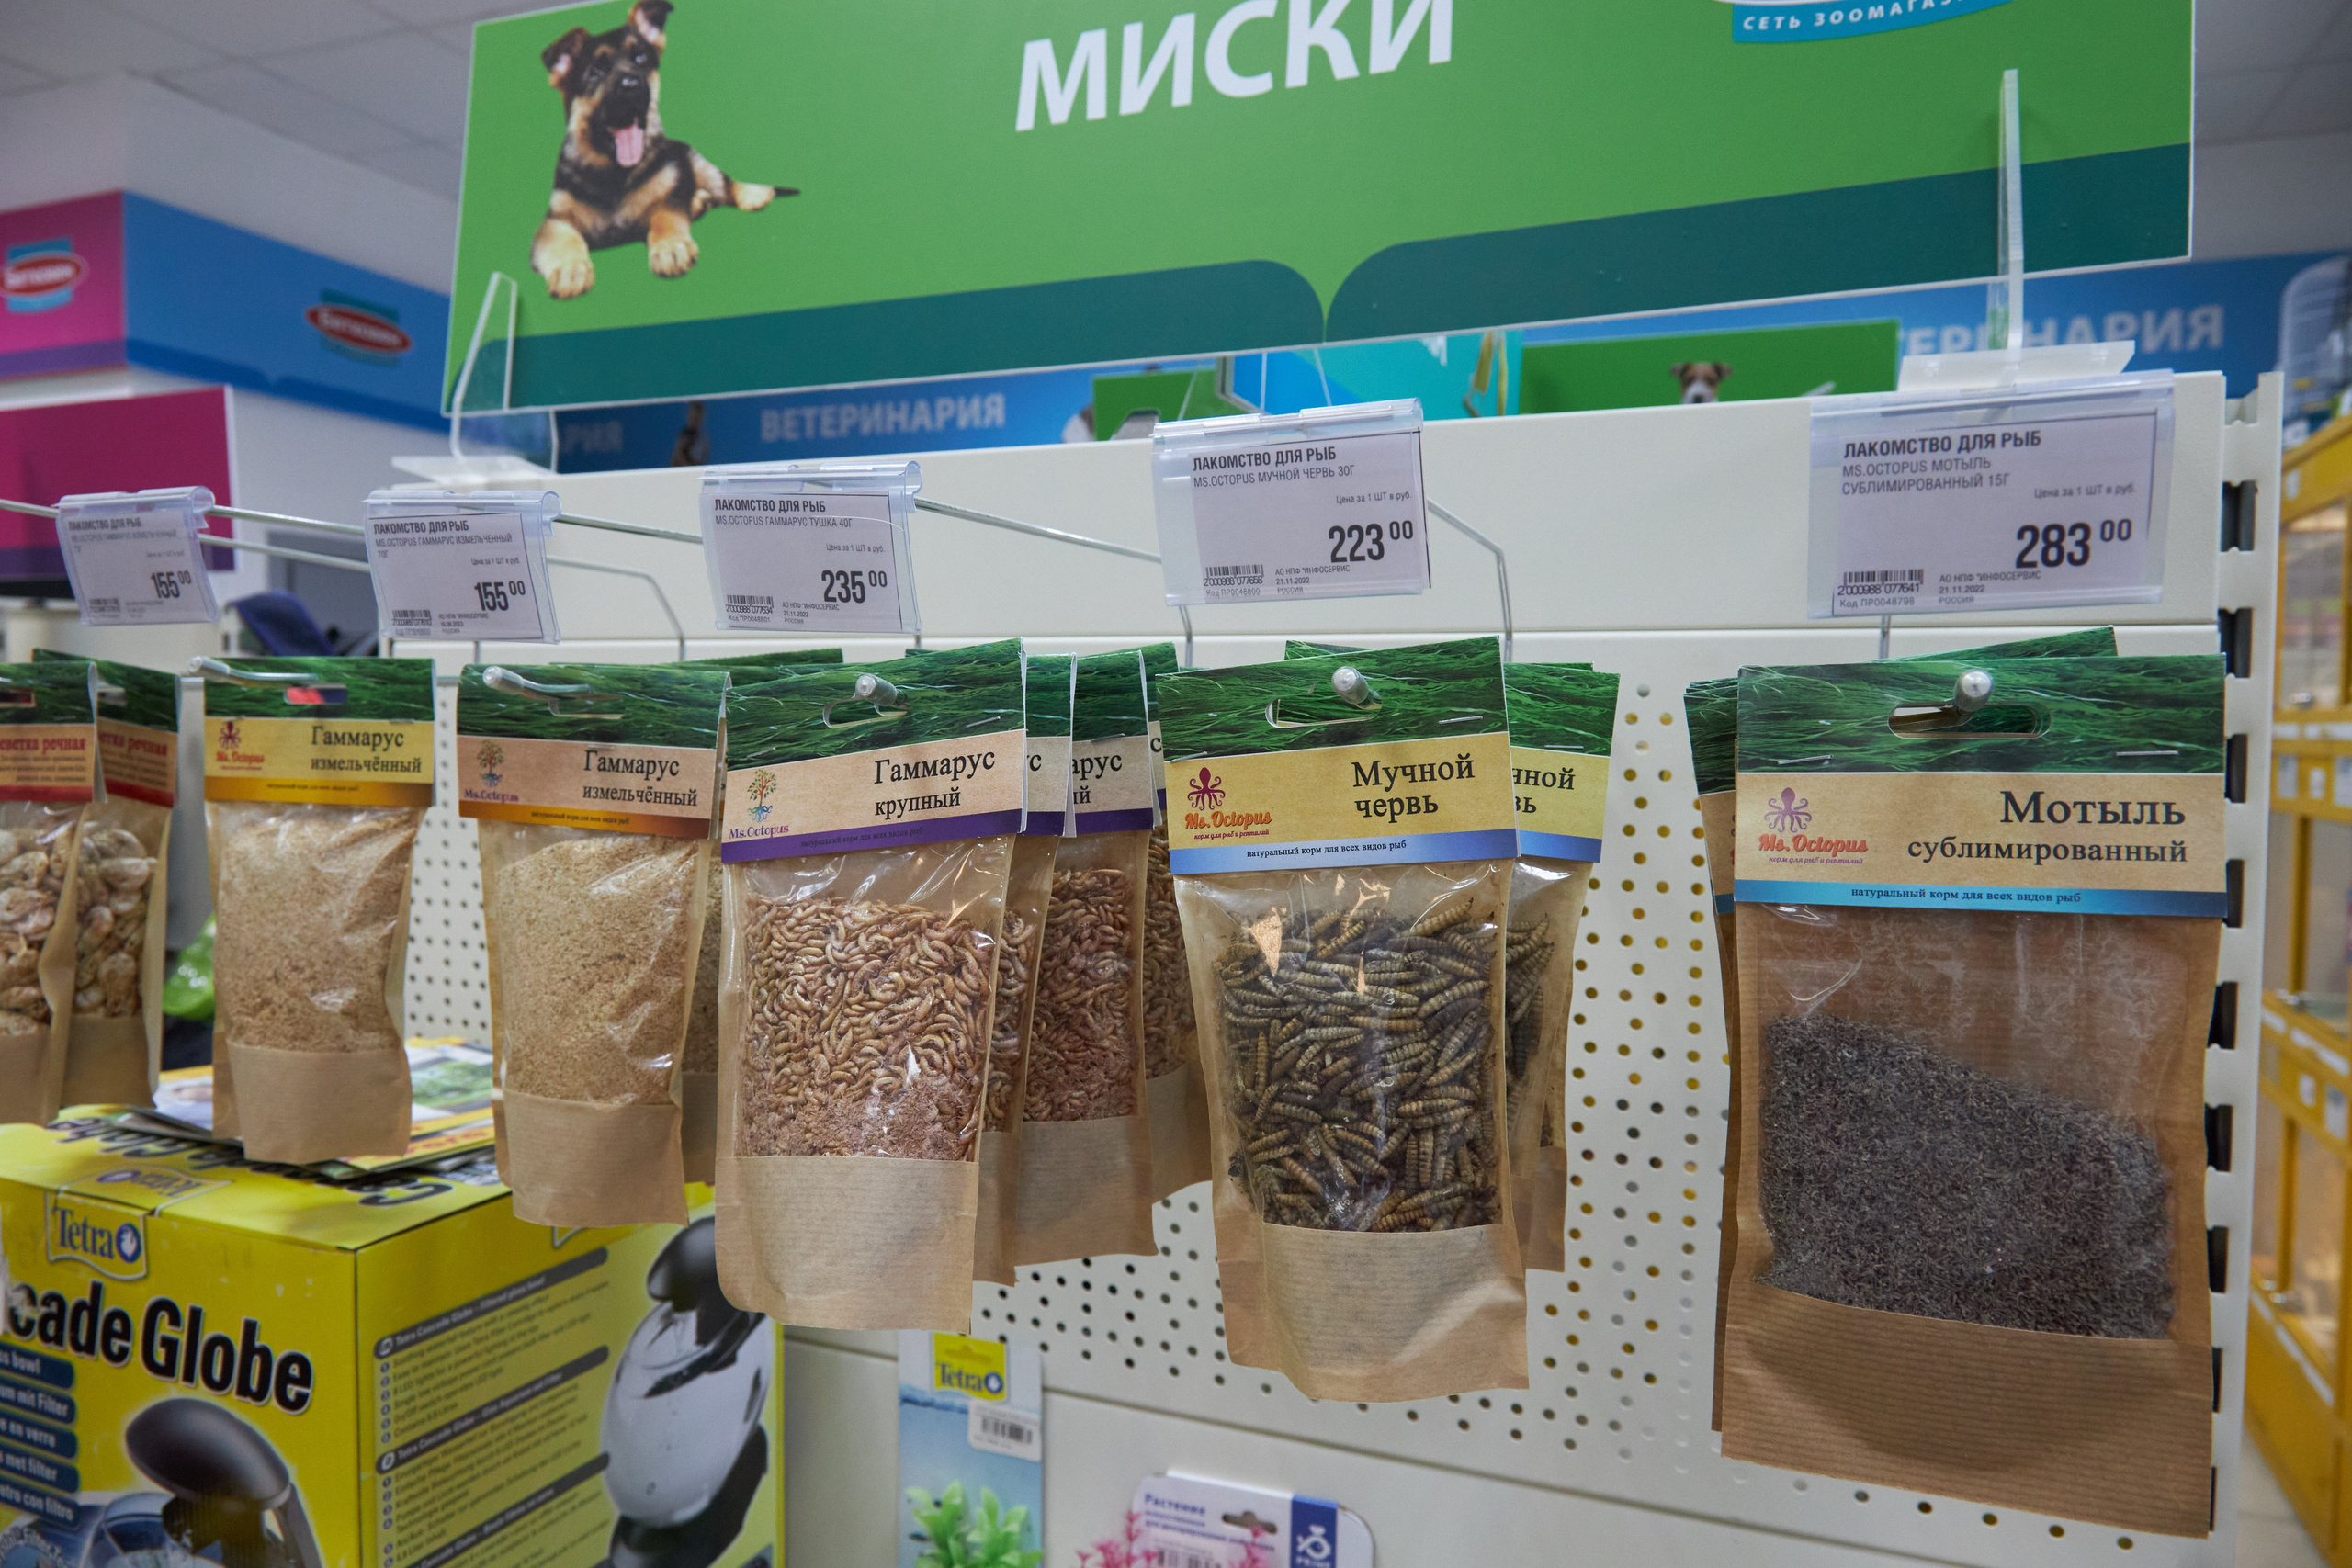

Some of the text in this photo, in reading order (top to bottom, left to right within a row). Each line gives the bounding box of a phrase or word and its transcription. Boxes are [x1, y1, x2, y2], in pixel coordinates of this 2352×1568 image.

[1743, 17, 1801, 30] СЕТЬ
[1014, 0, 1454, 132] МИСКИ
[760, 393, 1005, 442] ВЕТЕРИНАРИЯ
[1844, 431, 2041, 458] ЛАКОМСТВО ДЛЯ РЫБ
[1193, 446, 1336, 471] ЛАКОМСТВО ДЛЯ РЫБ
[1843, 457, 1991, 477] MS.OCTOPUS МОТЫЛЬ
[1194, 474, 1255, 487] MS.OCTOPUS
[1259, 468, 1299, 482] МУЧНОЙ
[1303, 467, 1334, 479] ЧЕРВЬ
[1842, 473, 2009, 495] СУБЛИМИРОВАННЫЙ 15Г
[1336, 495, 1353, 505] Цена
[1374, 492, 1386, 501] ШТ
[1396, 491, 1411, 502] руб.
[2034, 488, 2059, 500] Цена
[2064, 489, 2073, 497] за
[2076, 486, 2081, 496] 1
[2086, 485, 2102, 495] ШТ
[2115, 483, 2136, 497] руб.
[715, 499, 825, 513] ЛАКОМСТВО ДЛЯ РЫБ
[69, 517, 141, 531] ЛАКОМСТВО ДЛЯ РЫБ
[374, 520, 469, 535] ЛАКОМСТВО ДЛЯ РЫБ
[716, 516, 852, 527] MS.OCTOPUS ГАММАРУС ТУШКА 40Г
[418, 536, 454, 546] ГАММАРУС
[827, 544, 841, 552] Цена
[1329, 520, 1413, 562] 223 00
[2016, 519, 2132, 569] 283 00
[151, 570, 191, 598] 155 00
[821, 570, 887, 604] 235 00
[1939, 584, 1984, 593] 21.11.2022
[1954, 573, 1973, 582] НПФ
[474, 581, 526, 612] 155 00
[1206, 589, 1219, 597] Код
[1840, 599, 1858, 608] Код
[1939, 596, 1974, 604] РОССИЯ
[42, 738, 86, 755] речная
[311, 726, 404, 751] Гаммарус
[311, 757, 422, 773] измельчённый
[584, 750, 680, 782] Гаммарус
[874, 748, 995, 785] Гаммарус
[1351, 753, 1475, 791] Мучной
[582, 784, 698, 807] измельчённый
[875, 787, 961, 820] крупный
[1211, 810, 1272, 830] Octopus
[1354, 794, 1439, 824] червь
[2000, 791, 2186, 826] Мотыль
[1239, 829, 1269, 838] рептилий
[1247, 847, 1299, 858] натуральный
[1301, 847, 1321, 856] корм
[1362, 842, 1387, 851] видов
[1389, 840, 1407, 851] рыб
[1792, 834, 1869, 857] Octopus
[1907, 835, 2188, 866] сублимированный
[1851, 887, 2081, 904] натуральный корм для всех видов рыб
[53, 1207, 114, 1259] Tetra
[12, 1350, 41, 1374] bowl
[141, 1295, 313, 1416] Globe
[935, 1361, 983, 1392] Tetra
[38, 1393, 69, 1416] Filter
[26, 1427, 56, 1448] verre
[28, 1455, 58, 1482] filter
[47, 1496, 74, 1521] filtro
